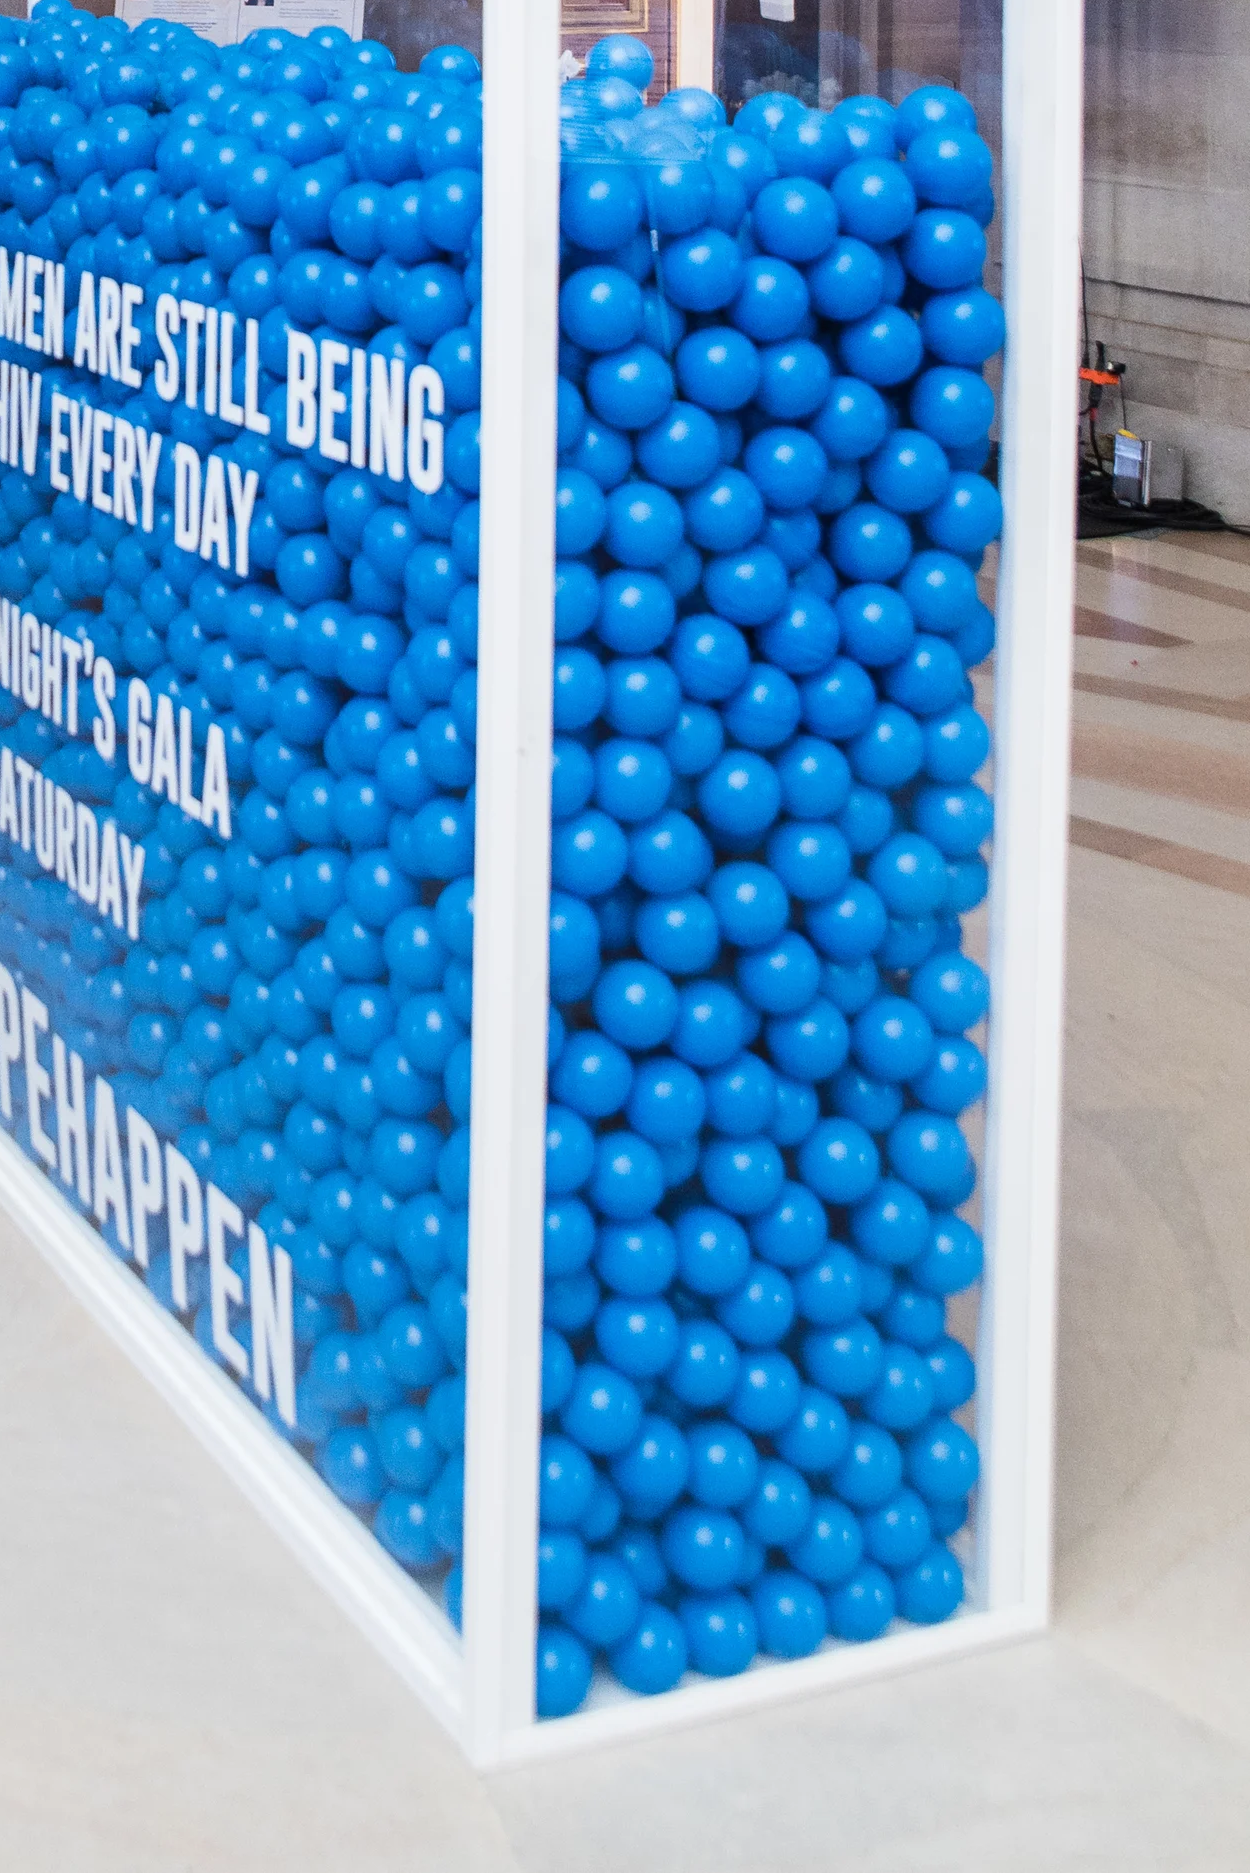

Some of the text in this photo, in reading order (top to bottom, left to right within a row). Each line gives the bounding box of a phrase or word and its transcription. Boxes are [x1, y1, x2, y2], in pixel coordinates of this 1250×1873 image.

[74, 272, 143, 388] ARE
[154, 294, 270, 434] STILL
[286, 330, 444, 494] BEING
[50, 392, 162, 533] EVERY
[173, 443, 259, 578] DAY
[128, 678, 232, 838] GALA
